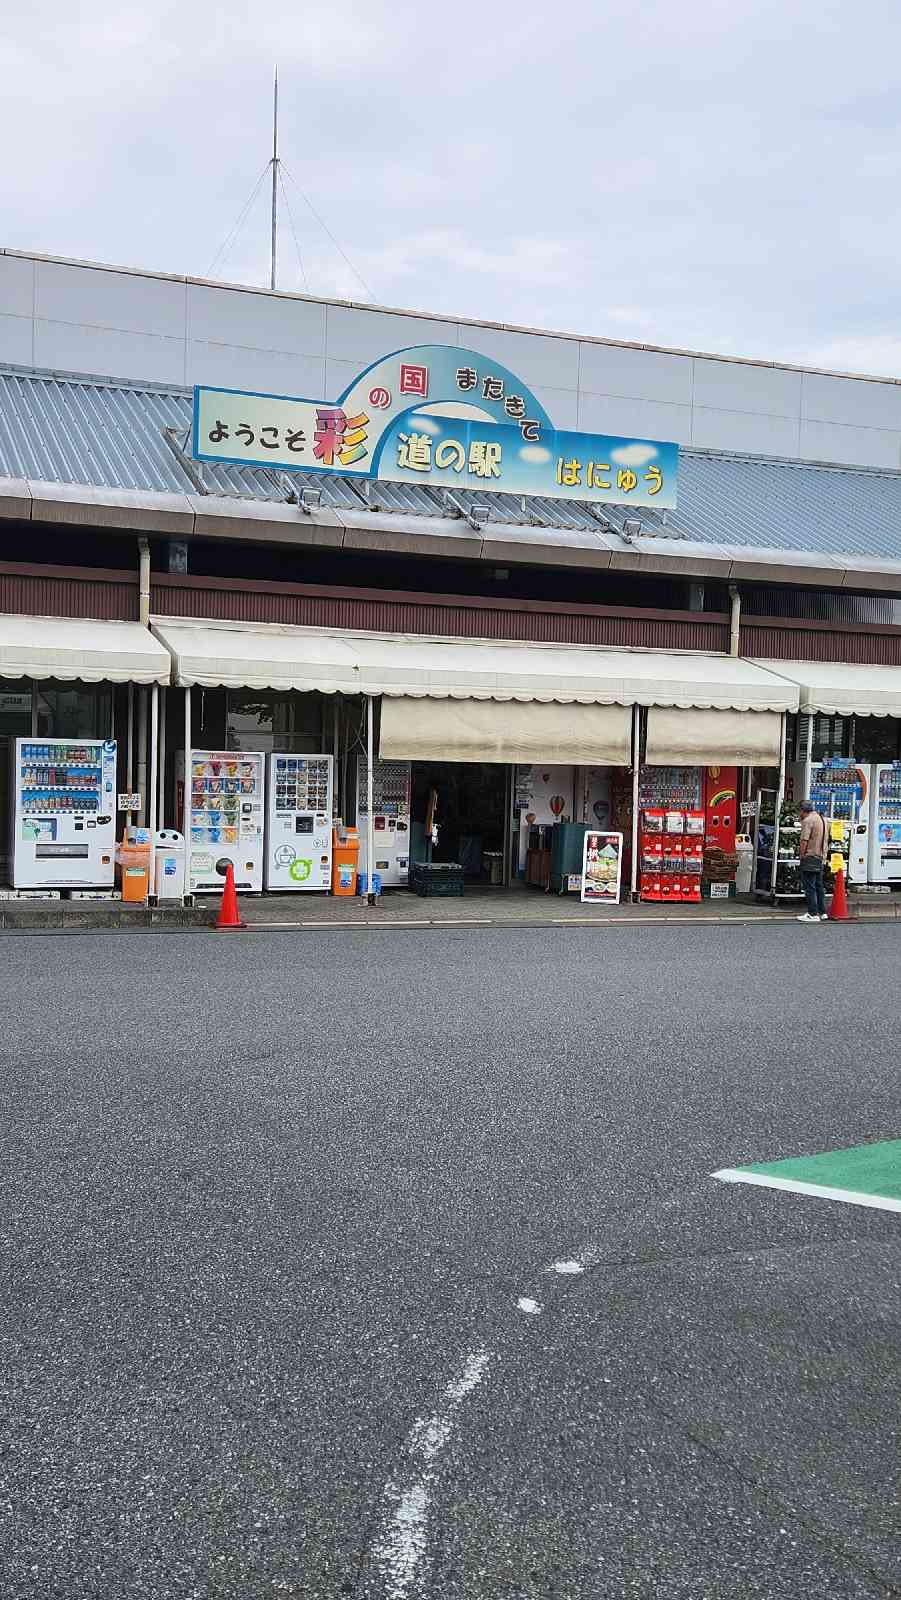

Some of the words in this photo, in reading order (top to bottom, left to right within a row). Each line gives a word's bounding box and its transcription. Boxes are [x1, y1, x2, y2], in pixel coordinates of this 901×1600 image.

[208, 420, 306, 453] ようこそ
[313, 364, 428, 466] 彩の国
[456, 367, 541, 441] またきて
[397, 433, 503, 478] 道の駅
[556, 457, 664, 494] はにゅう
